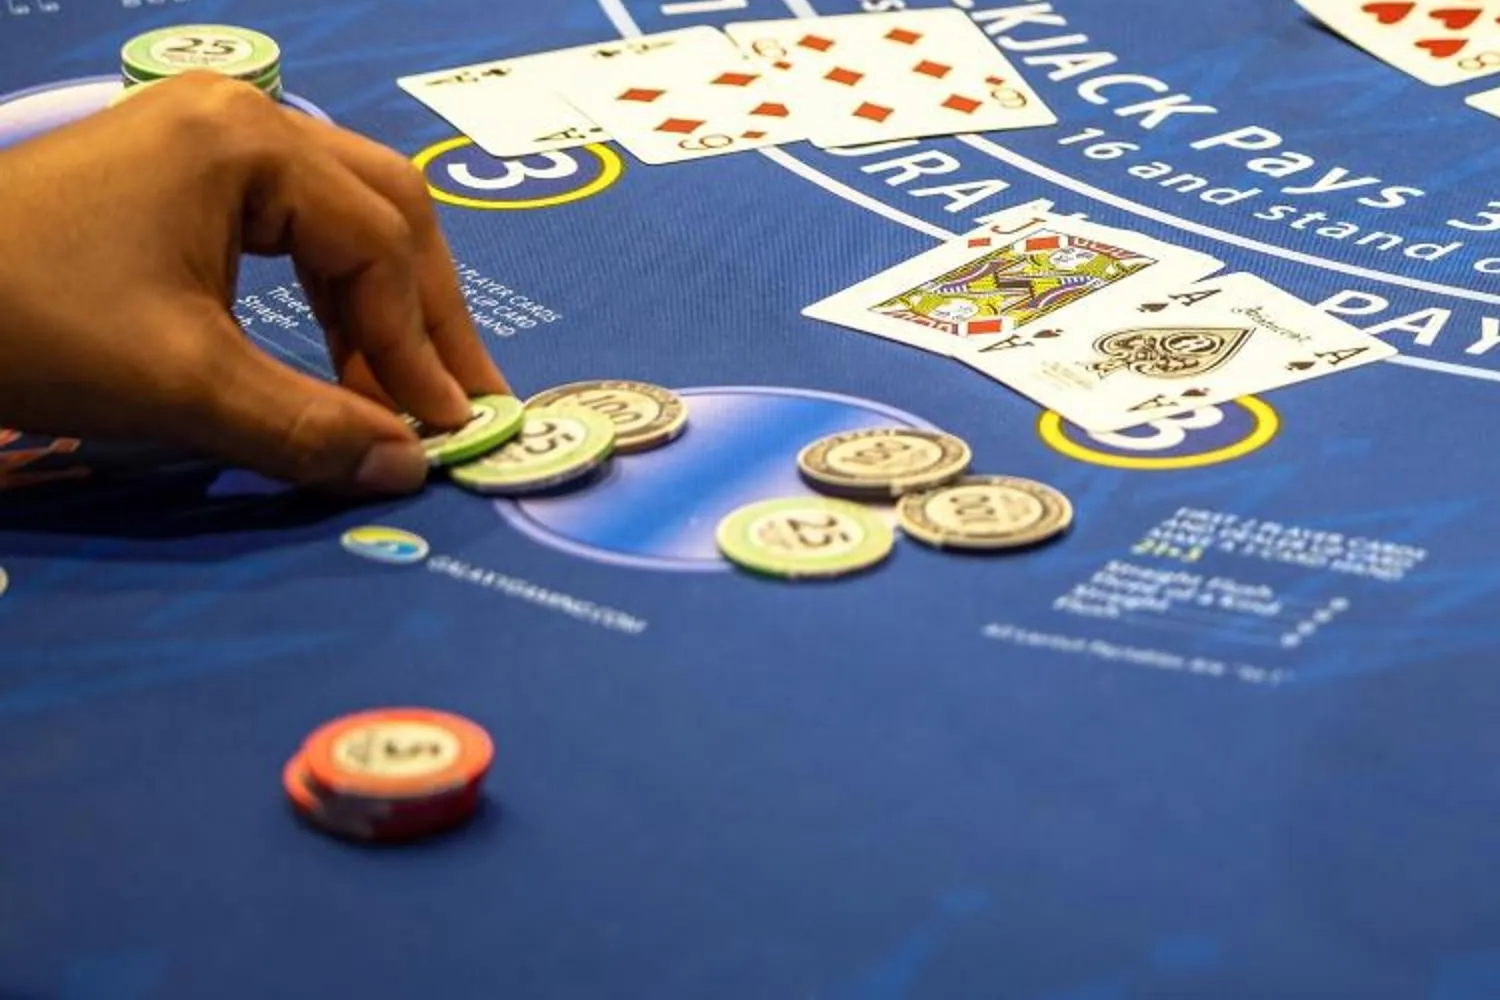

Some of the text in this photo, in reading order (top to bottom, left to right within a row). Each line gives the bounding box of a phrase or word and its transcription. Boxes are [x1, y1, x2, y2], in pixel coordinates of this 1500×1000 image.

[165, 37, 237, 55] 25
[1189, 125, 1425, 209] Pays
[1057, 127, 1140, 160] 16
[1127, 159, 1262, 206] and
[1253, 204, 1462, 261] stand
[990, 216, 1048, 236] J
[1168, 287, 1223, 308] A
[509, 295, 562, 323] CARDS
[977, 334, 1037, 354] A
[1313, 345, 1371, 366] A
[1127, 393, 1180, 412] A
